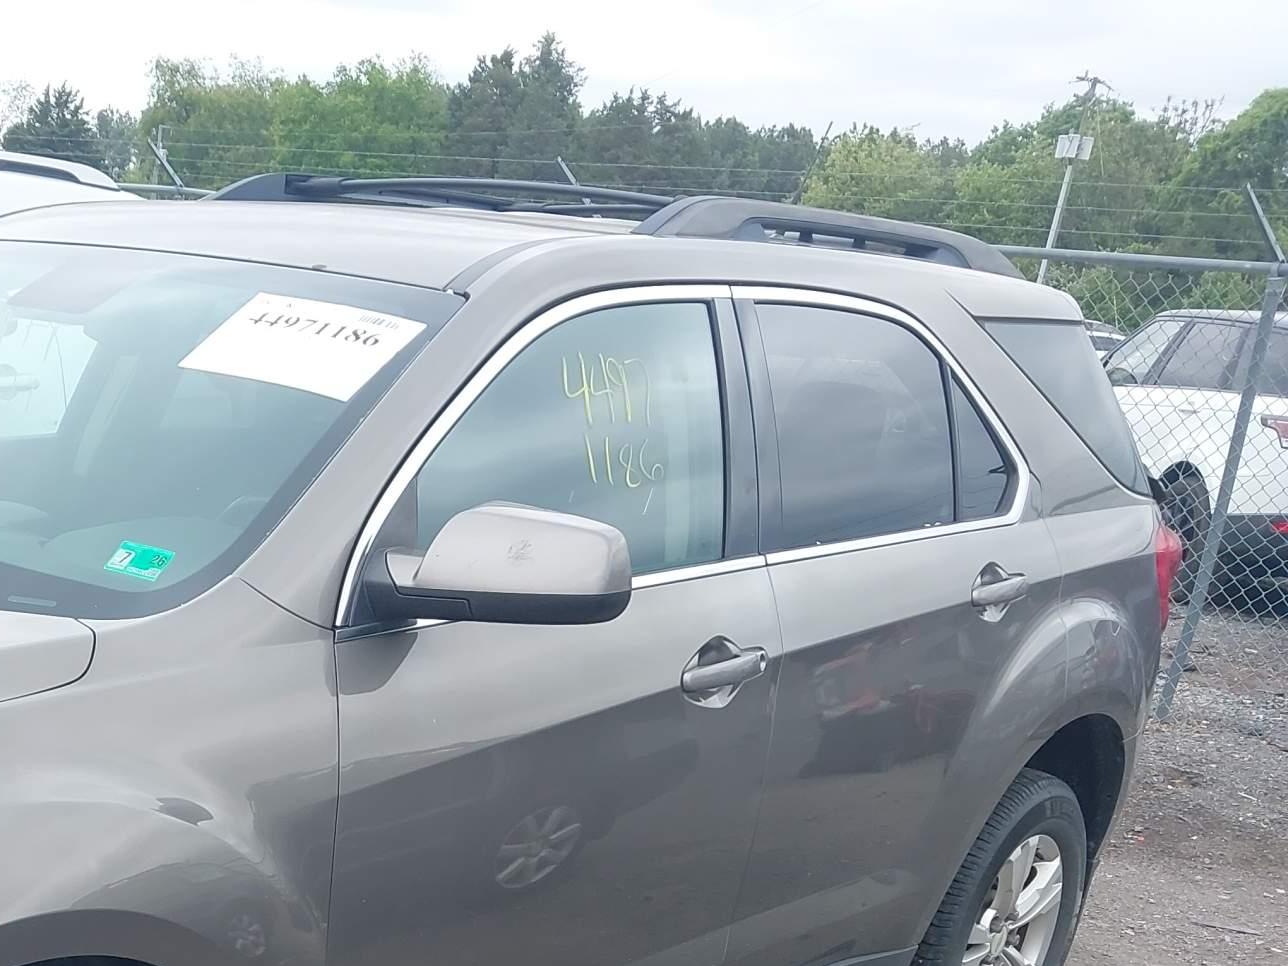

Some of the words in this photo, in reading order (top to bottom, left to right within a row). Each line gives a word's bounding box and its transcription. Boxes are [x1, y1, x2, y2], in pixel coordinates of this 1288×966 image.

[248, 311, 381, 346] 44971186
[562, 351, 651, 427] 4497
[584, 432, 664, 487] 1186
